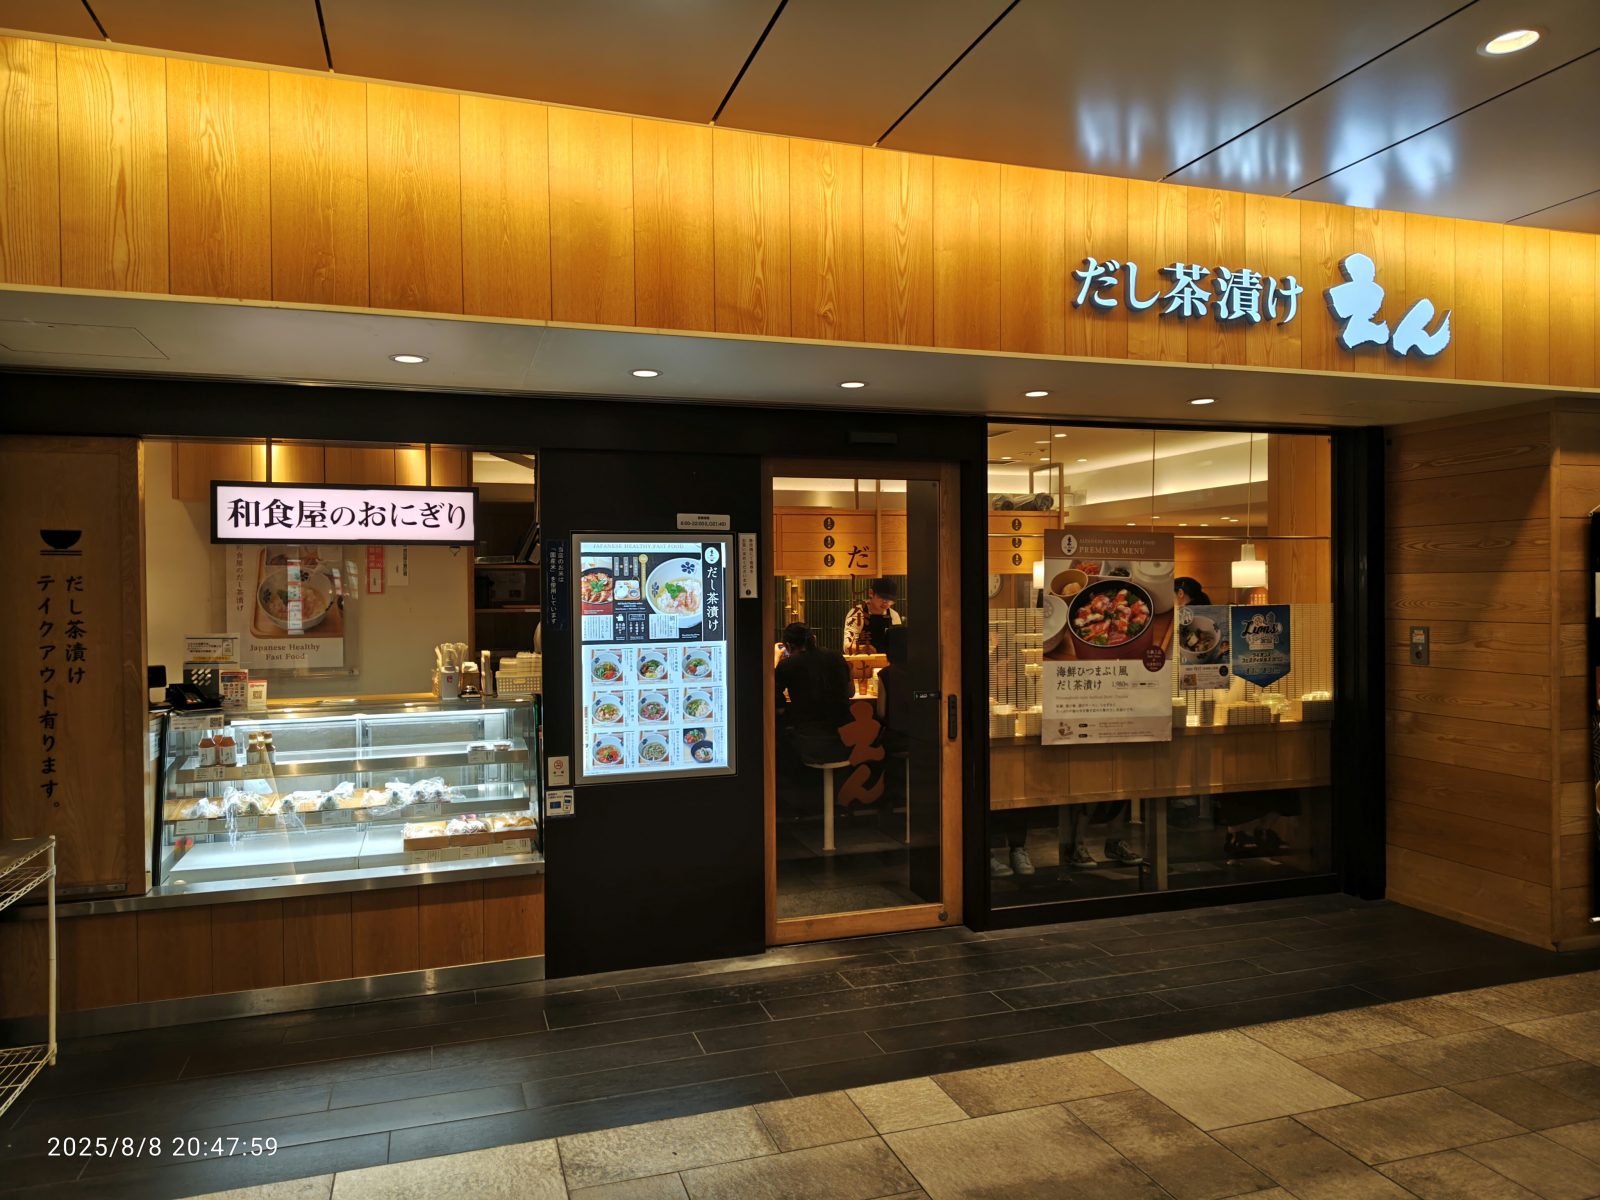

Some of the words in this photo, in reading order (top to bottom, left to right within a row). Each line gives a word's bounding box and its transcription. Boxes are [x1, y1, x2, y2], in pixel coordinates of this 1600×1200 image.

[1073, 256, 1304, 326] だし茶漬け
[1326, 252, 1452, 357] えん
[227, 498, 466, 530] 和食屋のおにぎり
[1079, 546, 1119, 554] PREMIUM
[1121, 547, 1145, 555] MENU
[706, 566, 719, 631] だし茶漬け
[65, 575, 88, 685] だし茶漬け
[250, 644, 286, 652] Japanese
[289, 643, 320, 652] Healthy
[37, 575, 59, 808] テイクアウト有ります。
[1056, 665, 1129, 677] 海鮮ひつまぶし風
[1056, 680, 1102, 690] だし茶漬け
[838, 700, 886, 807] えん
